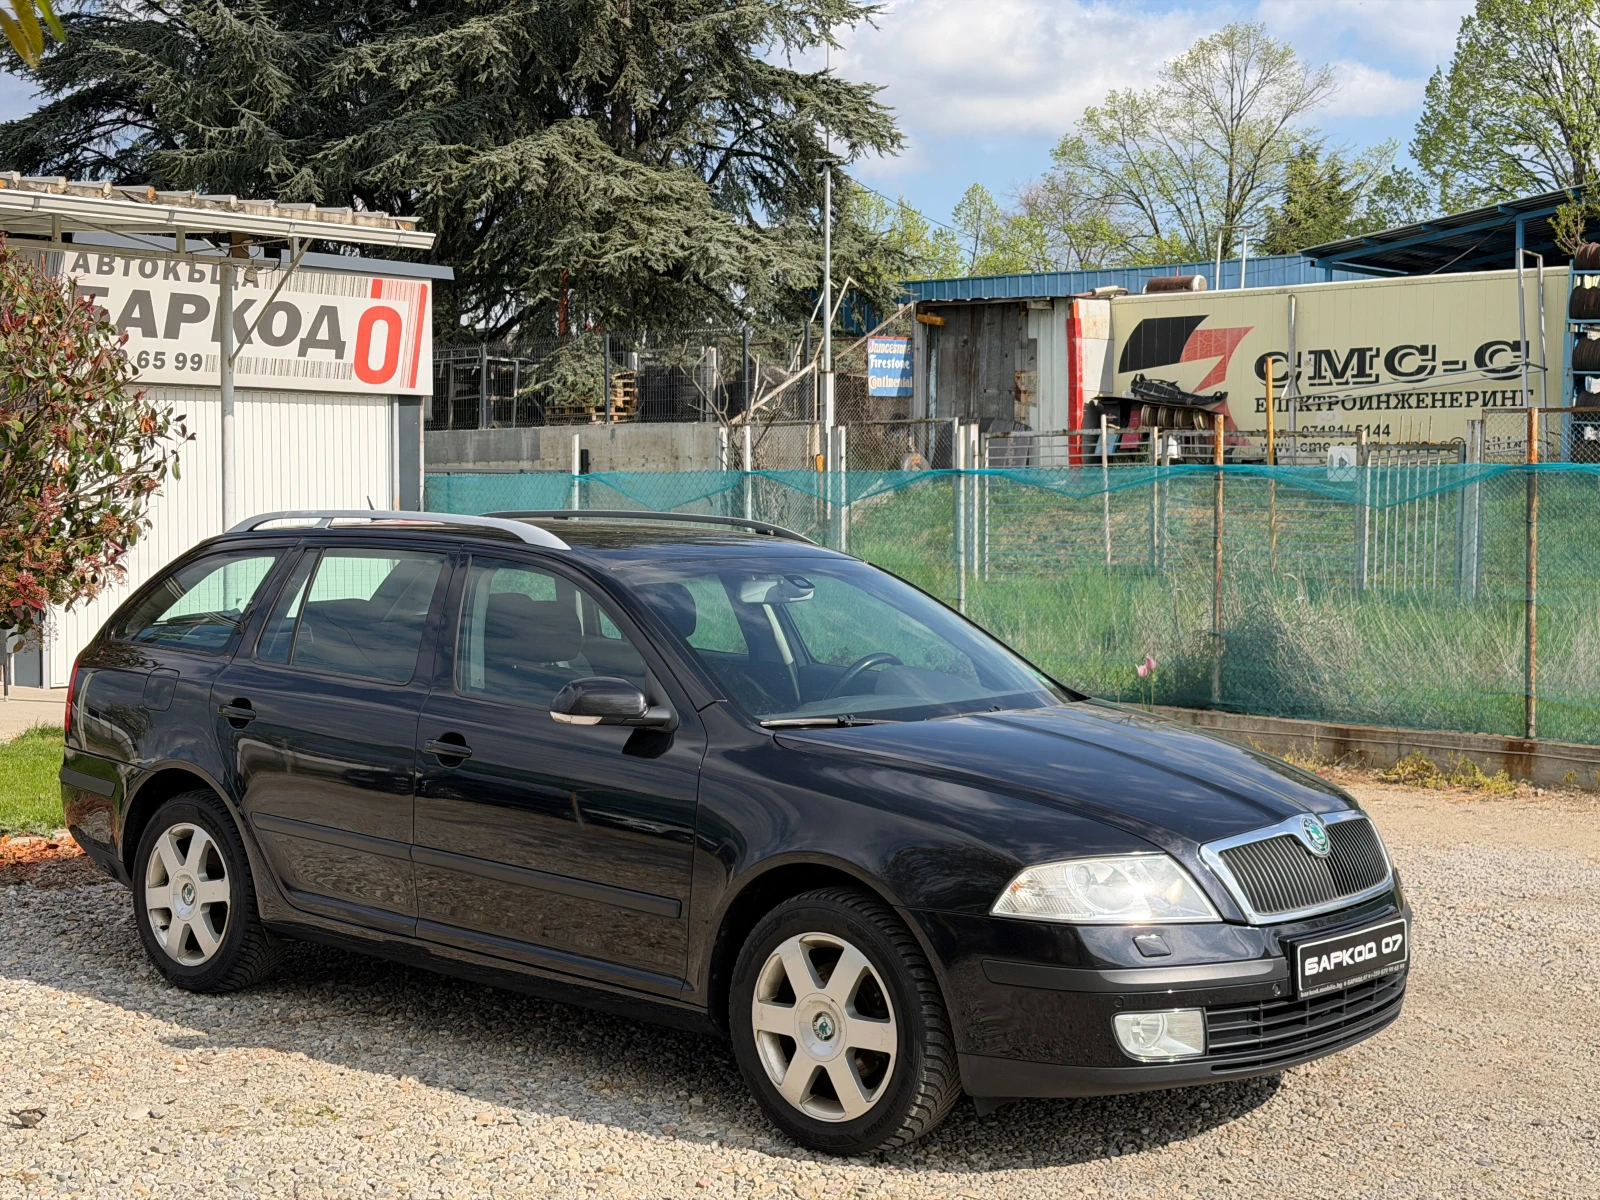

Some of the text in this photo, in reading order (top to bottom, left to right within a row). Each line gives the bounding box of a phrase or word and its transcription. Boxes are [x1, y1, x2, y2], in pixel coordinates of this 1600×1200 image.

[136, 350, 166, 370] 65
[174, 352, 203, 372] 99
[869, 354, 911, 369] Firestone
[868, 375, 913, 390] Continental
[1304, 934, 1403, 976] БАРКОД 07
